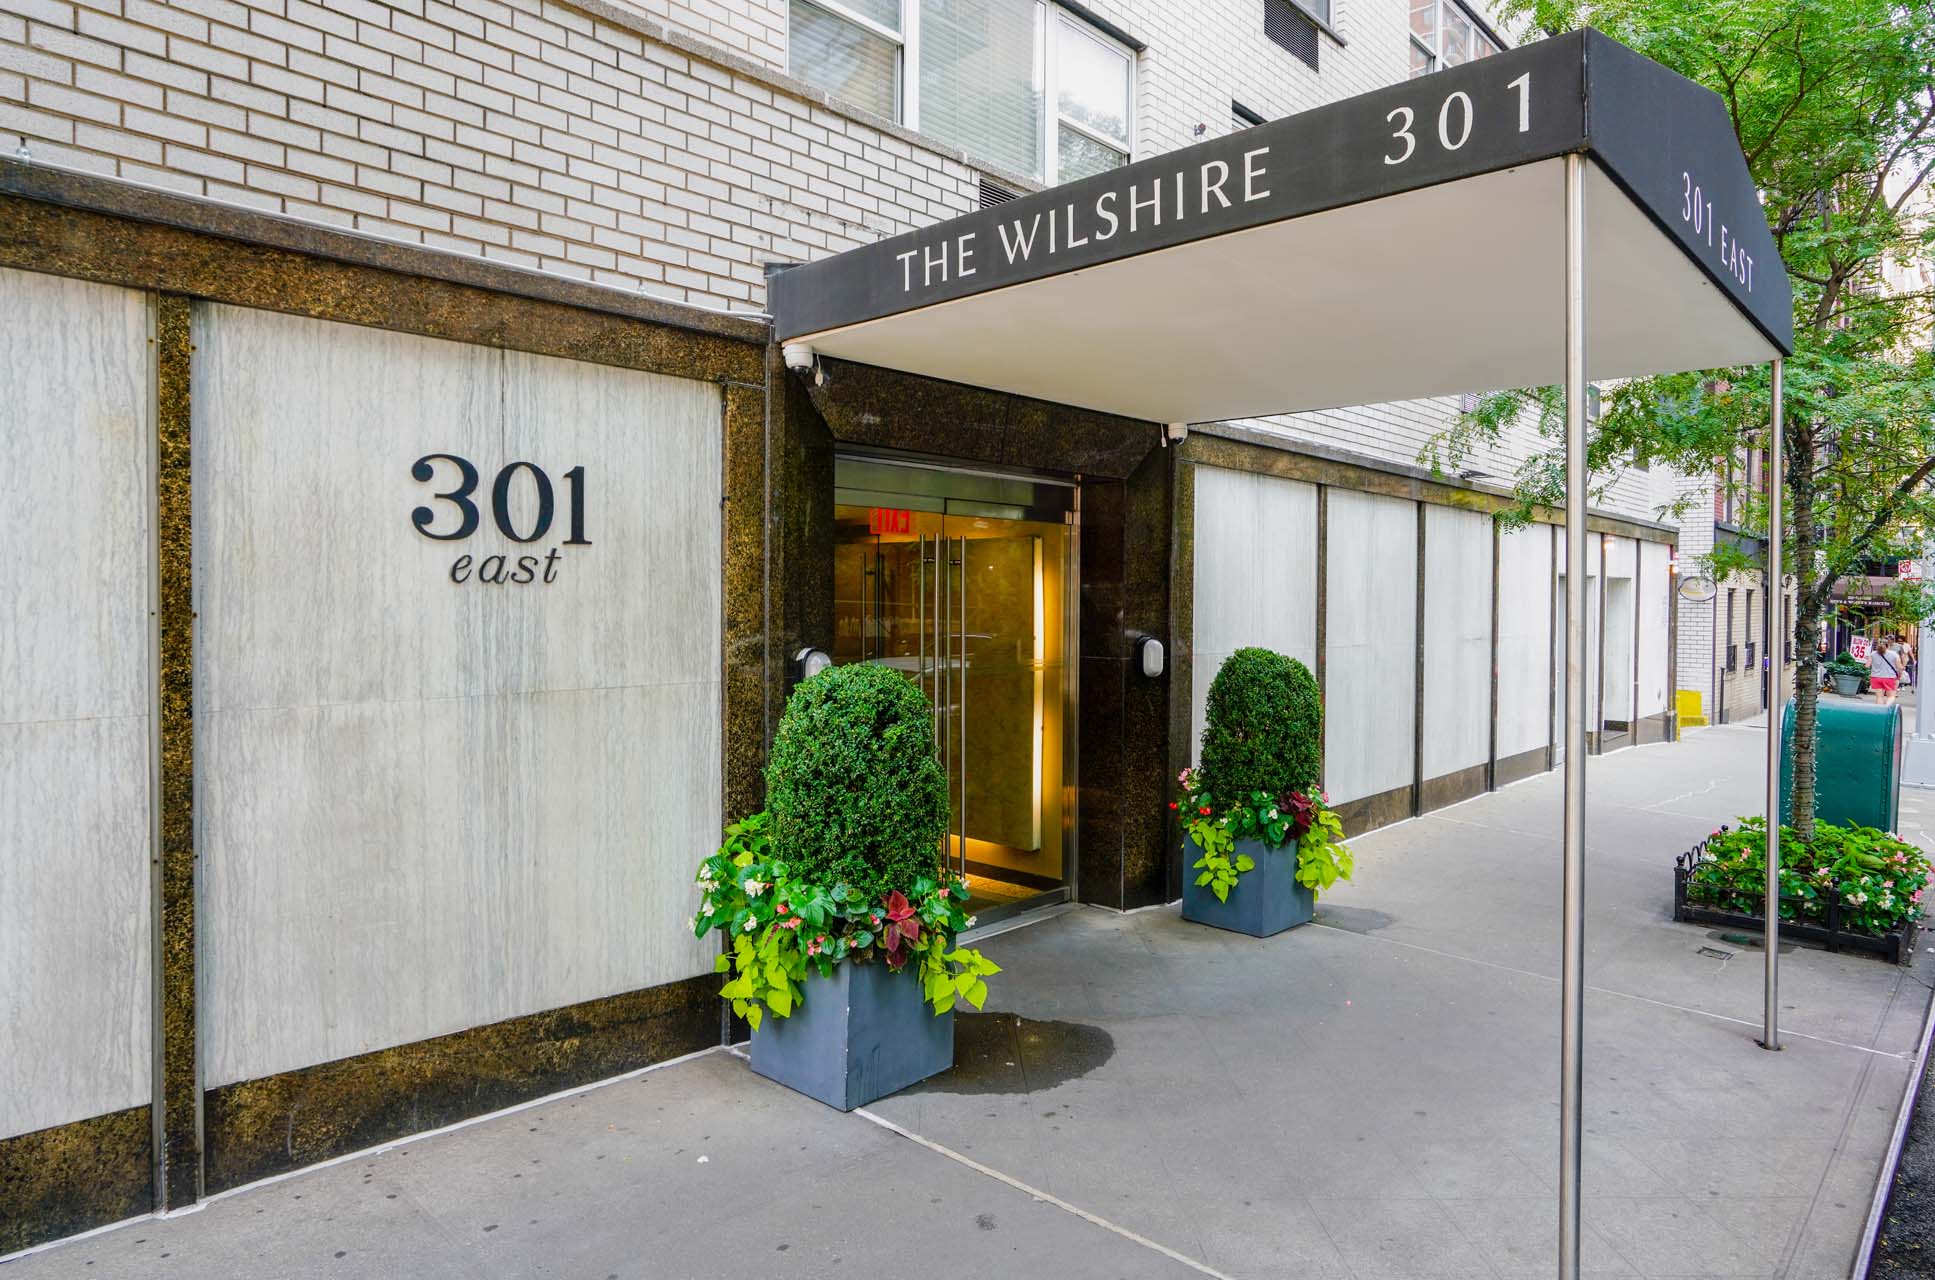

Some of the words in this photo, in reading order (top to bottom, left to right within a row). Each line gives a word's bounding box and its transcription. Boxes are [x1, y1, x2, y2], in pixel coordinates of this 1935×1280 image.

[896, 232, 977, 292] THE
[998, 146, 1271, 265] WILSHIRE
[1384, 72, 1530, 165] 301
[1682, 171, 1712, 248] 301
[1721, 224, 1754, 293] EAST
[411, 453, 593, 545] 301
[450, 548, 562, 585] east
